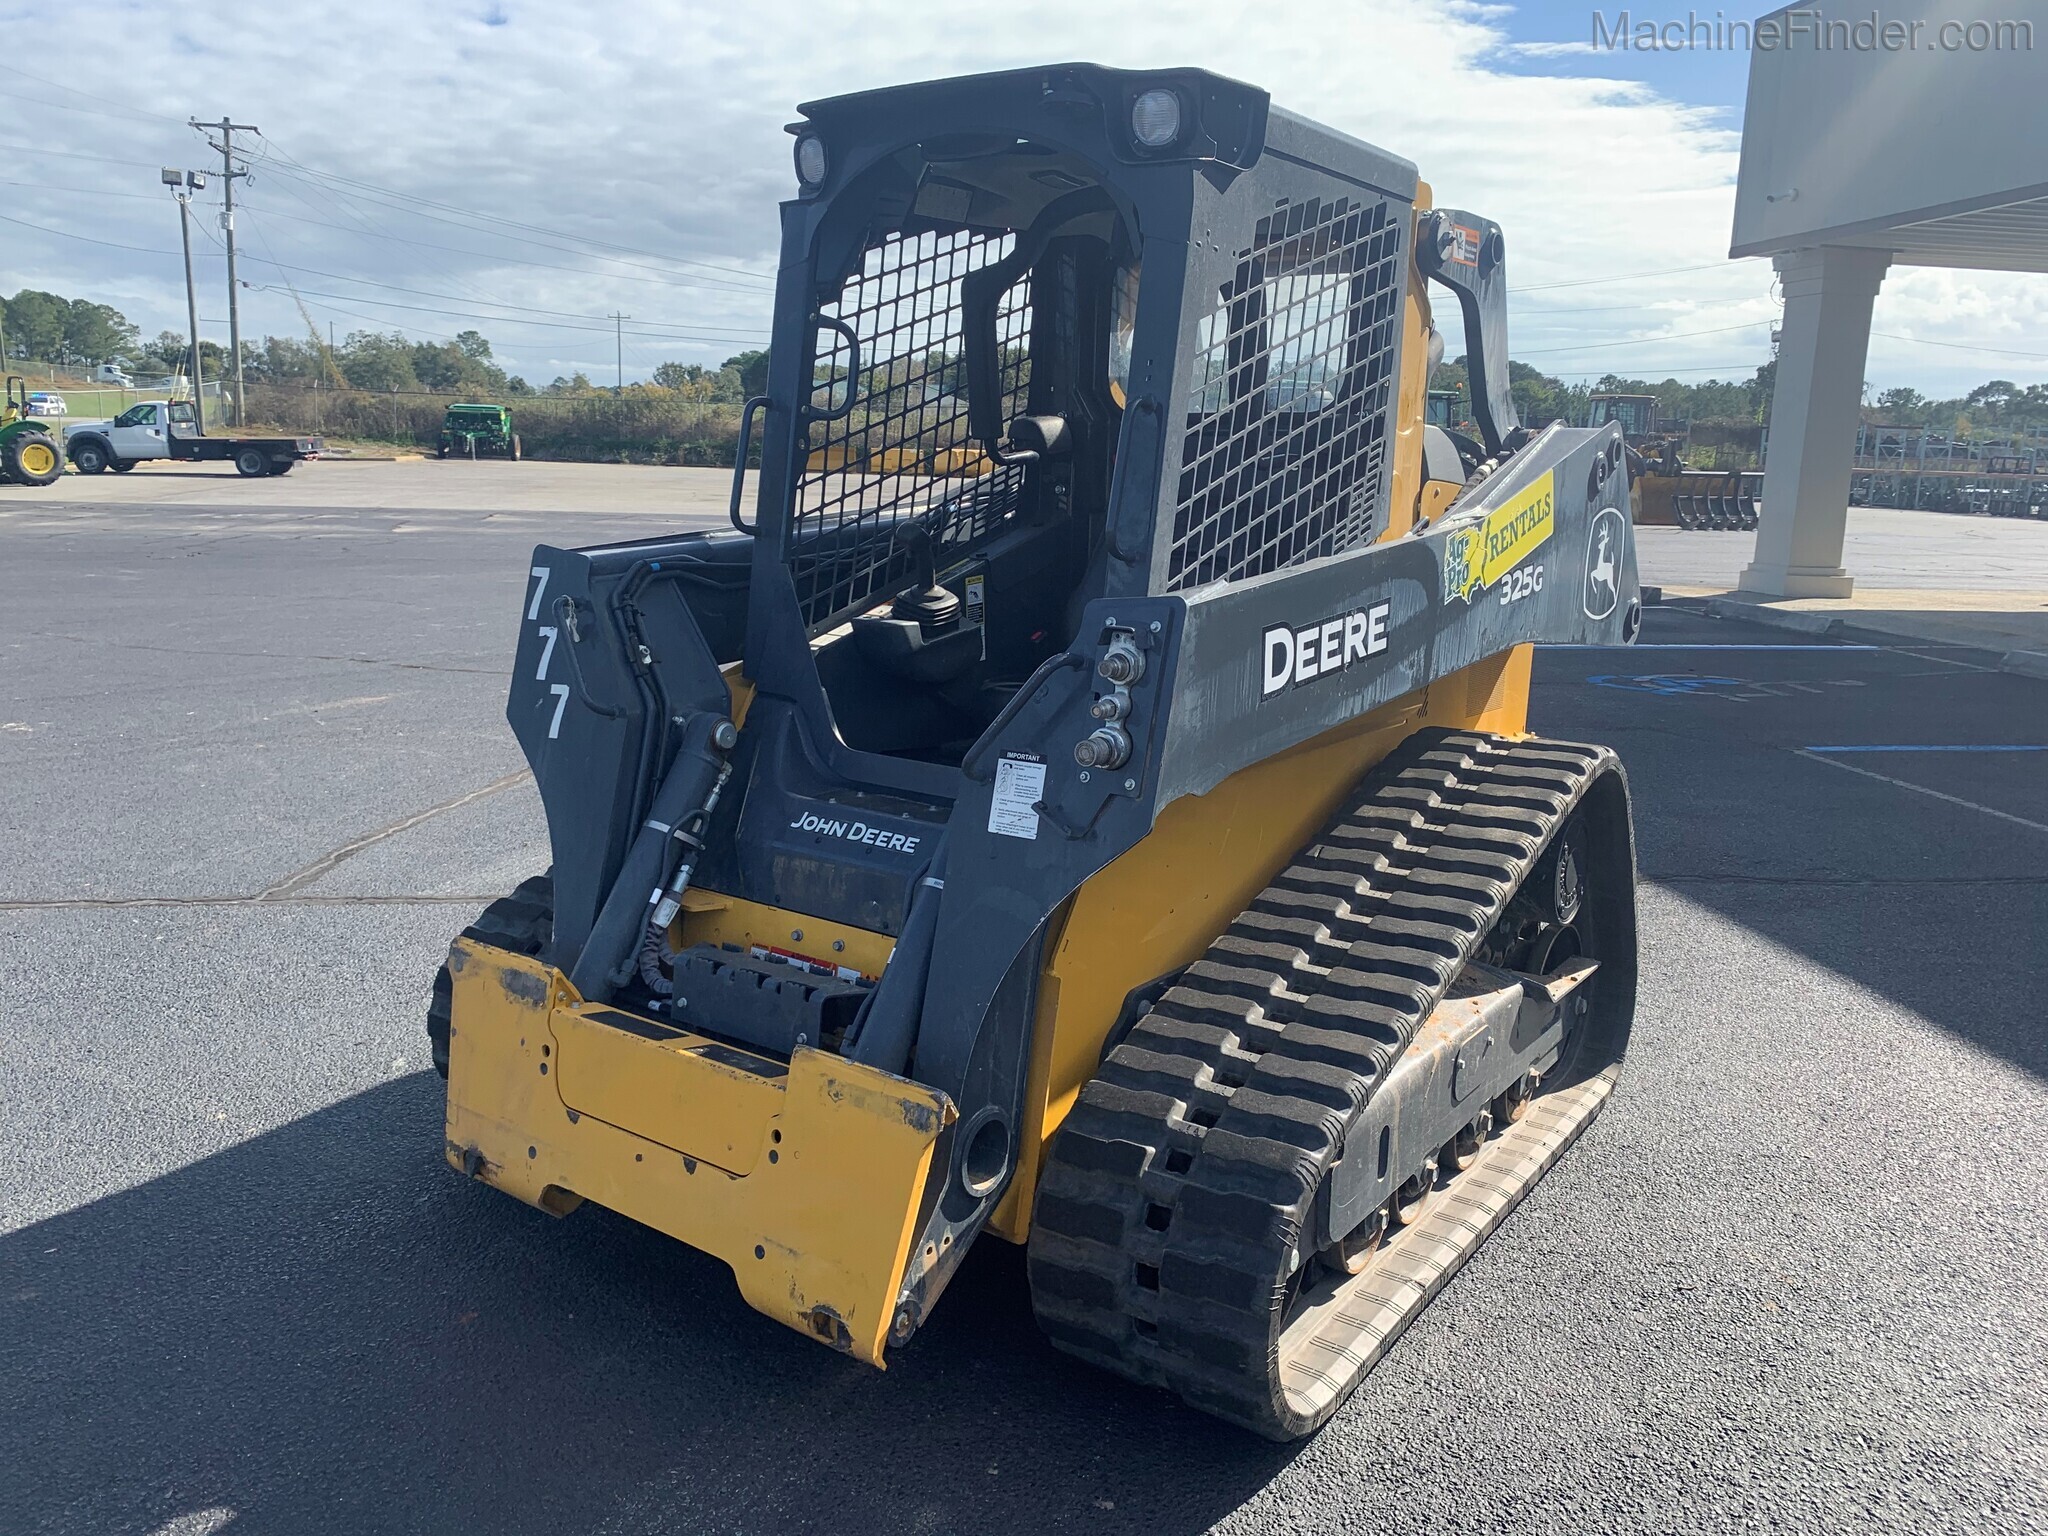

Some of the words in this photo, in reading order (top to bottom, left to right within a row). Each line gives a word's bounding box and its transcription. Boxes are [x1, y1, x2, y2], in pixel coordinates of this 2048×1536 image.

[1489, 491, 1551, 562] RENTALS
[1446, 560, 1470, 598] Pro
[1500, 565, 1543, 605] 325G
[1264, 603, 1389, 695] DEERE
[1006, 752, 1040, 762] IMPORTANT
[790, 811, 848, 838] JOHN
[846, 821, 920, 854] DEERE
